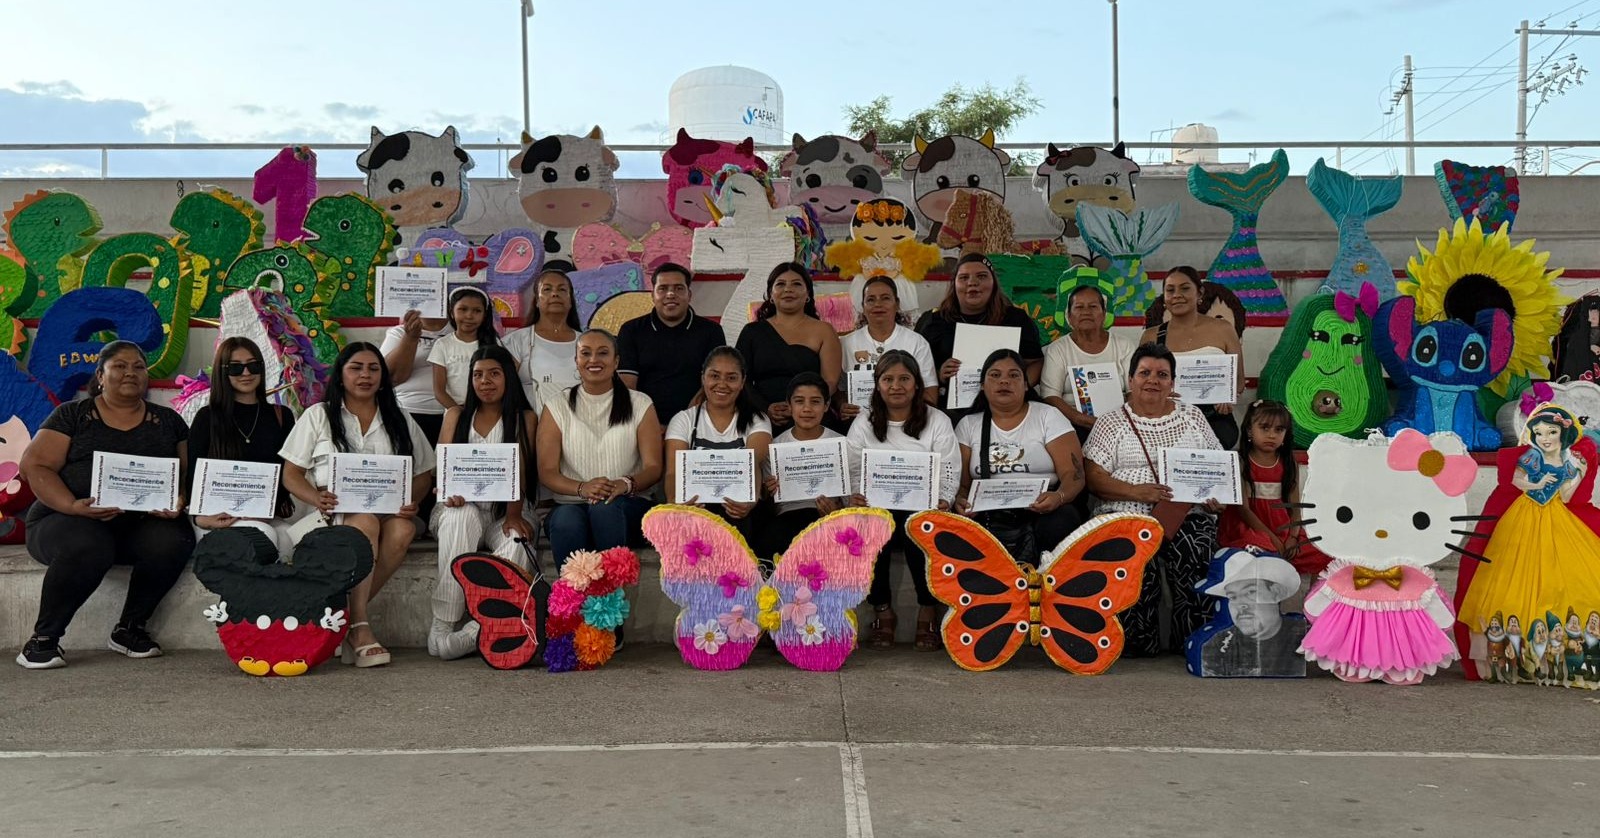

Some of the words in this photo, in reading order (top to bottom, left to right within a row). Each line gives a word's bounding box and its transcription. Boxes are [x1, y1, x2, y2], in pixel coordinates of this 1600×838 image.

[452, 465, 506, 473] Reconocimiento
[784, 462, 834, 472] Reconocimiento
[1173, 467, 1226, 477] Reconocimiento
[108, 474, 165, 485] Reconocimiento
[342, 476, 397, 485] Reconocimiento
[872, 472, 923, 481] Reconocimiento
[211, 480, 266, 490] Reconocimiento
